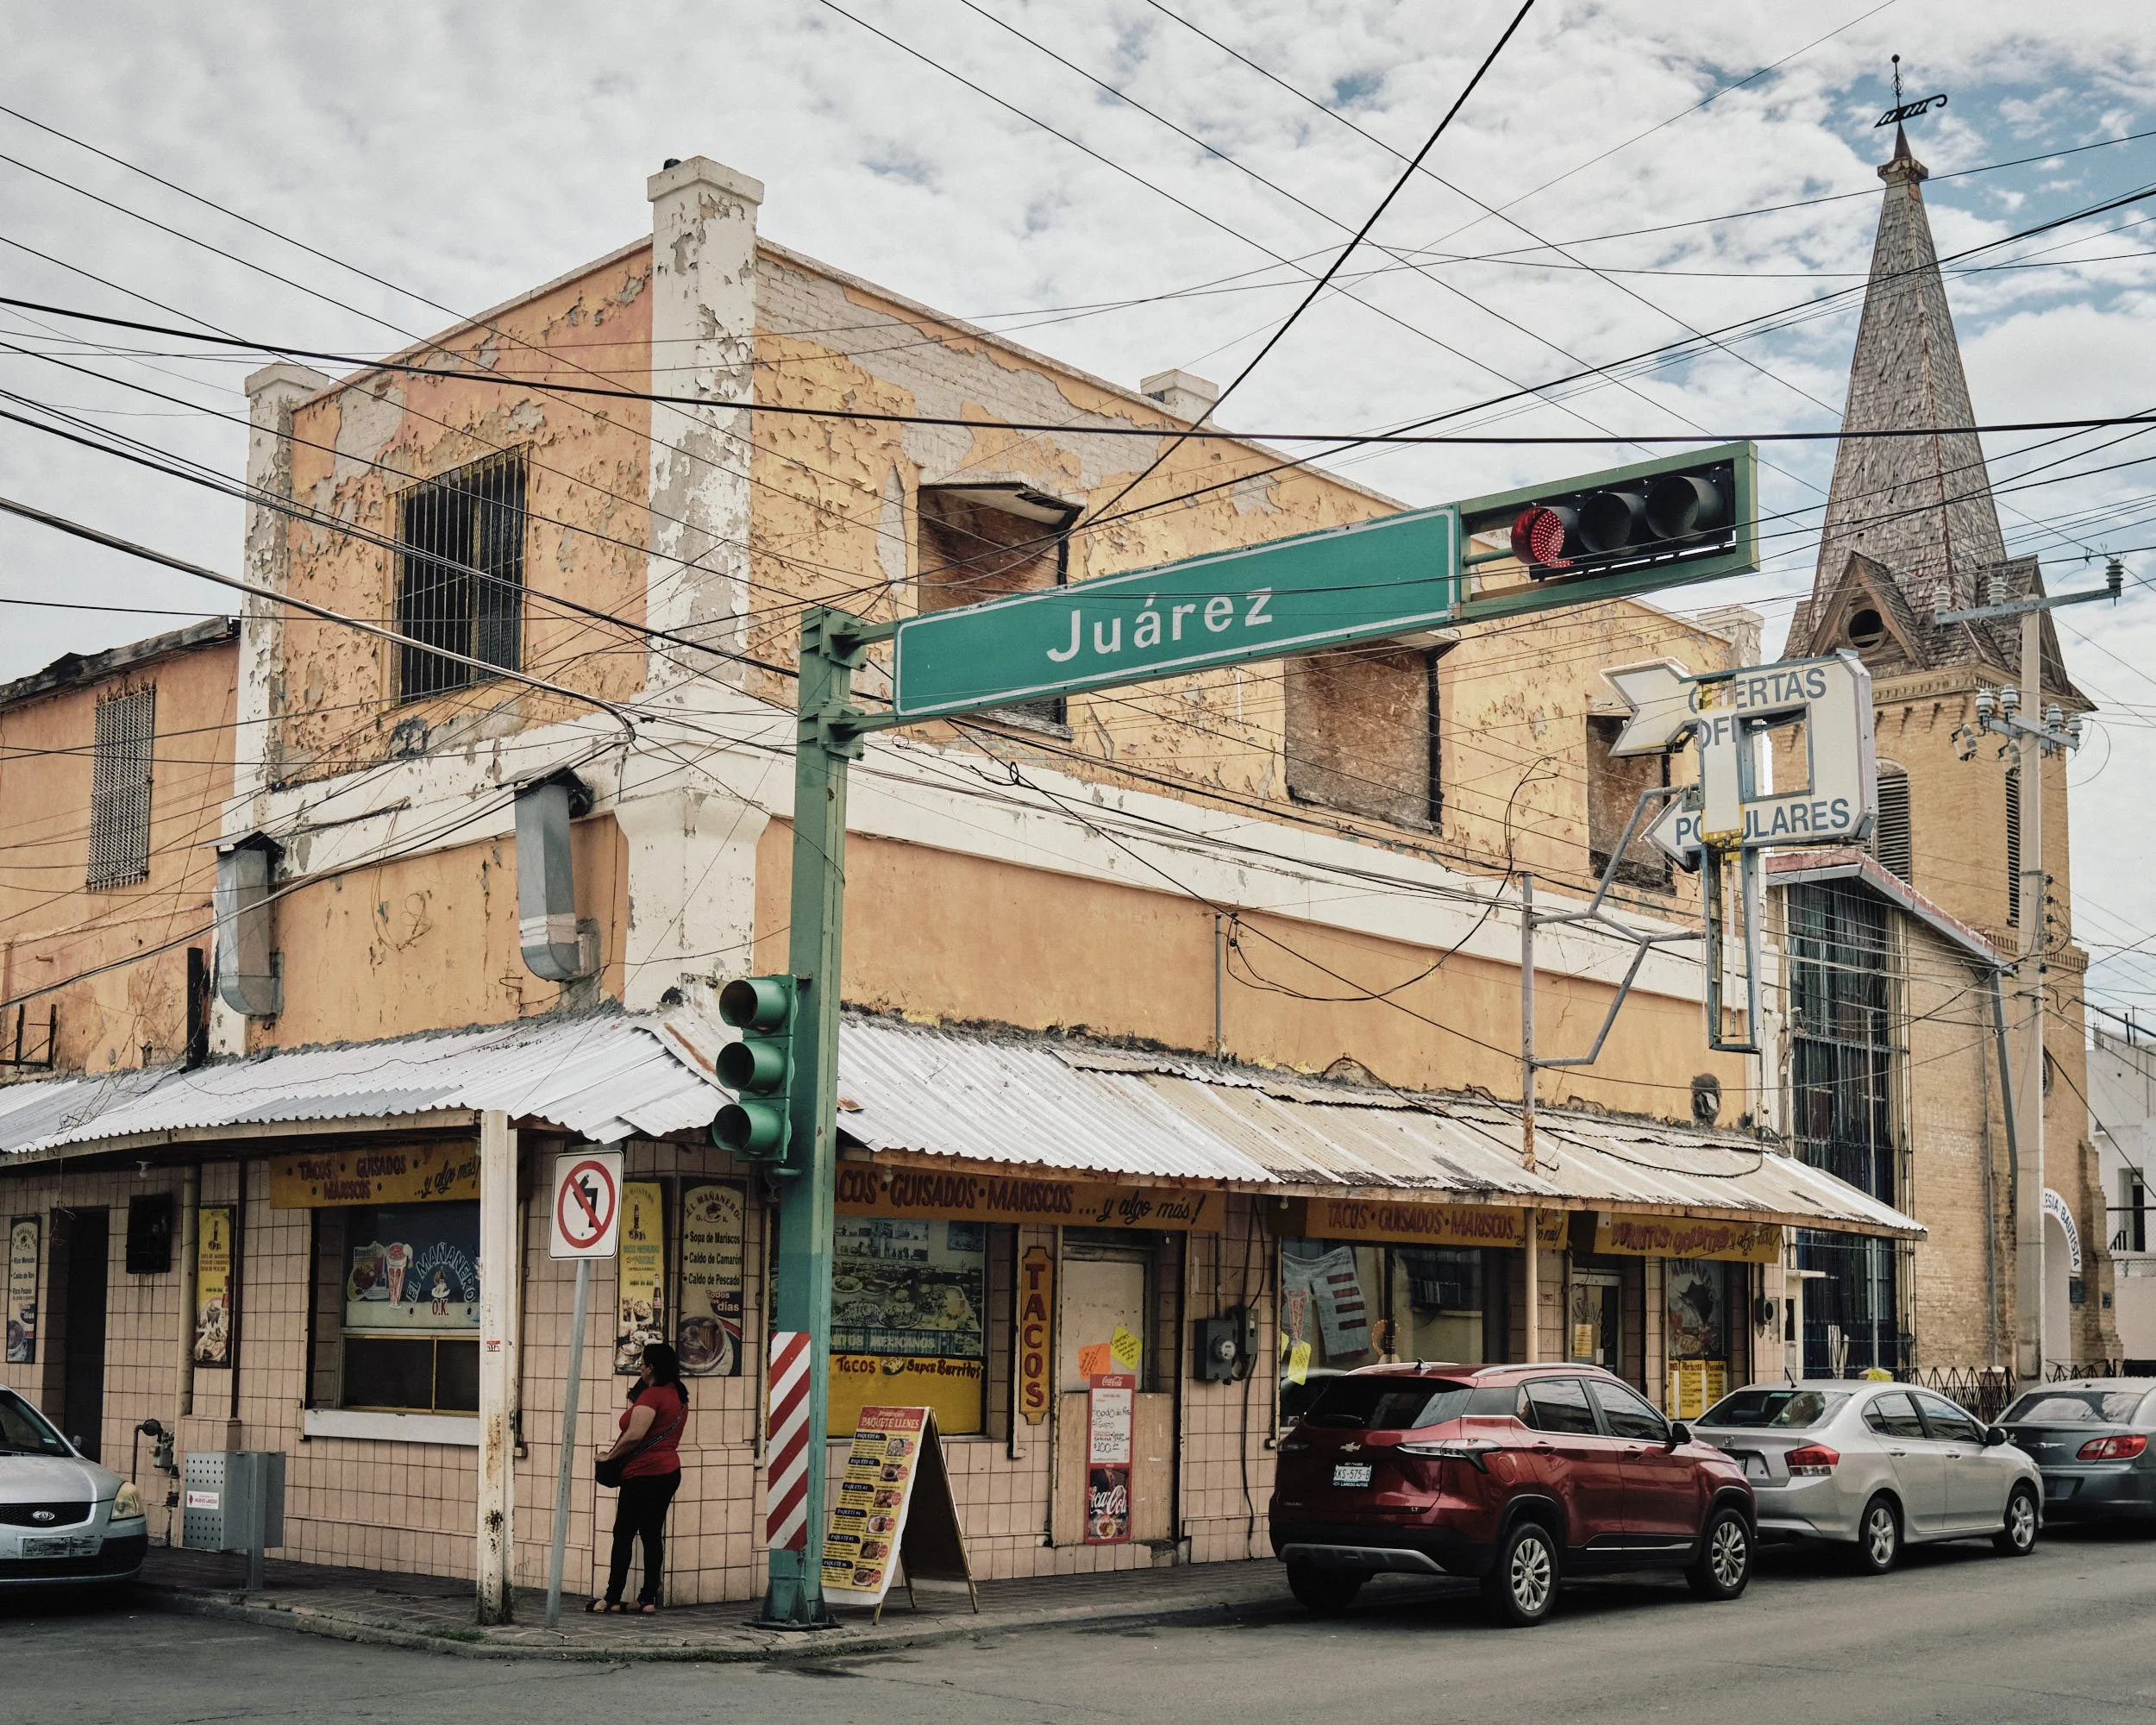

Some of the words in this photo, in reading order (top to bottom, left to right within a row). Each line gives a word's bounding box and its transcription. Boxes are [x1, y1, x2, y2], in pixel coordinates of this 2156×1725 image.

[1046, 587, 1273, 662] Juárez
[1676, 799, 1850, 846] POULARES
[298, 1158, 332, 1181] TACOS
[356, 1155, 407, 1177] GUISADOS
[323, 1180, 371, 1201] MARISCOS
[890, 1173, 977, 1209] GUISADOS
[987, 1179, 1075, 1214] MARISCOS
[1119, 1189, 1151, 1225] algo
[1157, 1193, 1206, 1225] más!
[1327, 1202, 1368, 1230] TACOS
[1380, 1208, 1444, 1235] GUISADOS
[1451, 1211, 1515, 1239] MARISCOS
[689, 1231, 705, 1245] Sopa
[706, 1232, 714, 1244] de
[715, 1232, 740, 1245] Mariscos
[2060, 1206, 2080, 1267] BAUTISTA
[689, 1252, 707, 1264] Caldo
[707, 1253, 716, 1264] de
[716, 1253, 742, 1265] Camarón
[405, 1281, 422, 1303] EL
[416, 1242, 475, 1303] MAÑANERO
[688, 1273, 706, 1285] Caldo
[707, 1274, 715, 1285] de
[716, 1274, 740, 1286] Pescado
[431, 1298, 450, 1316] O.K.
[718, 1301, 740, 1312] días
[1023, 1263, 1047, 1408] TACOS
[937, 1359, 981, 1380] Burritos
[862, 1417, 893, 1427] PAQUETE
[894, 1419, 919, 1428] LLENES
